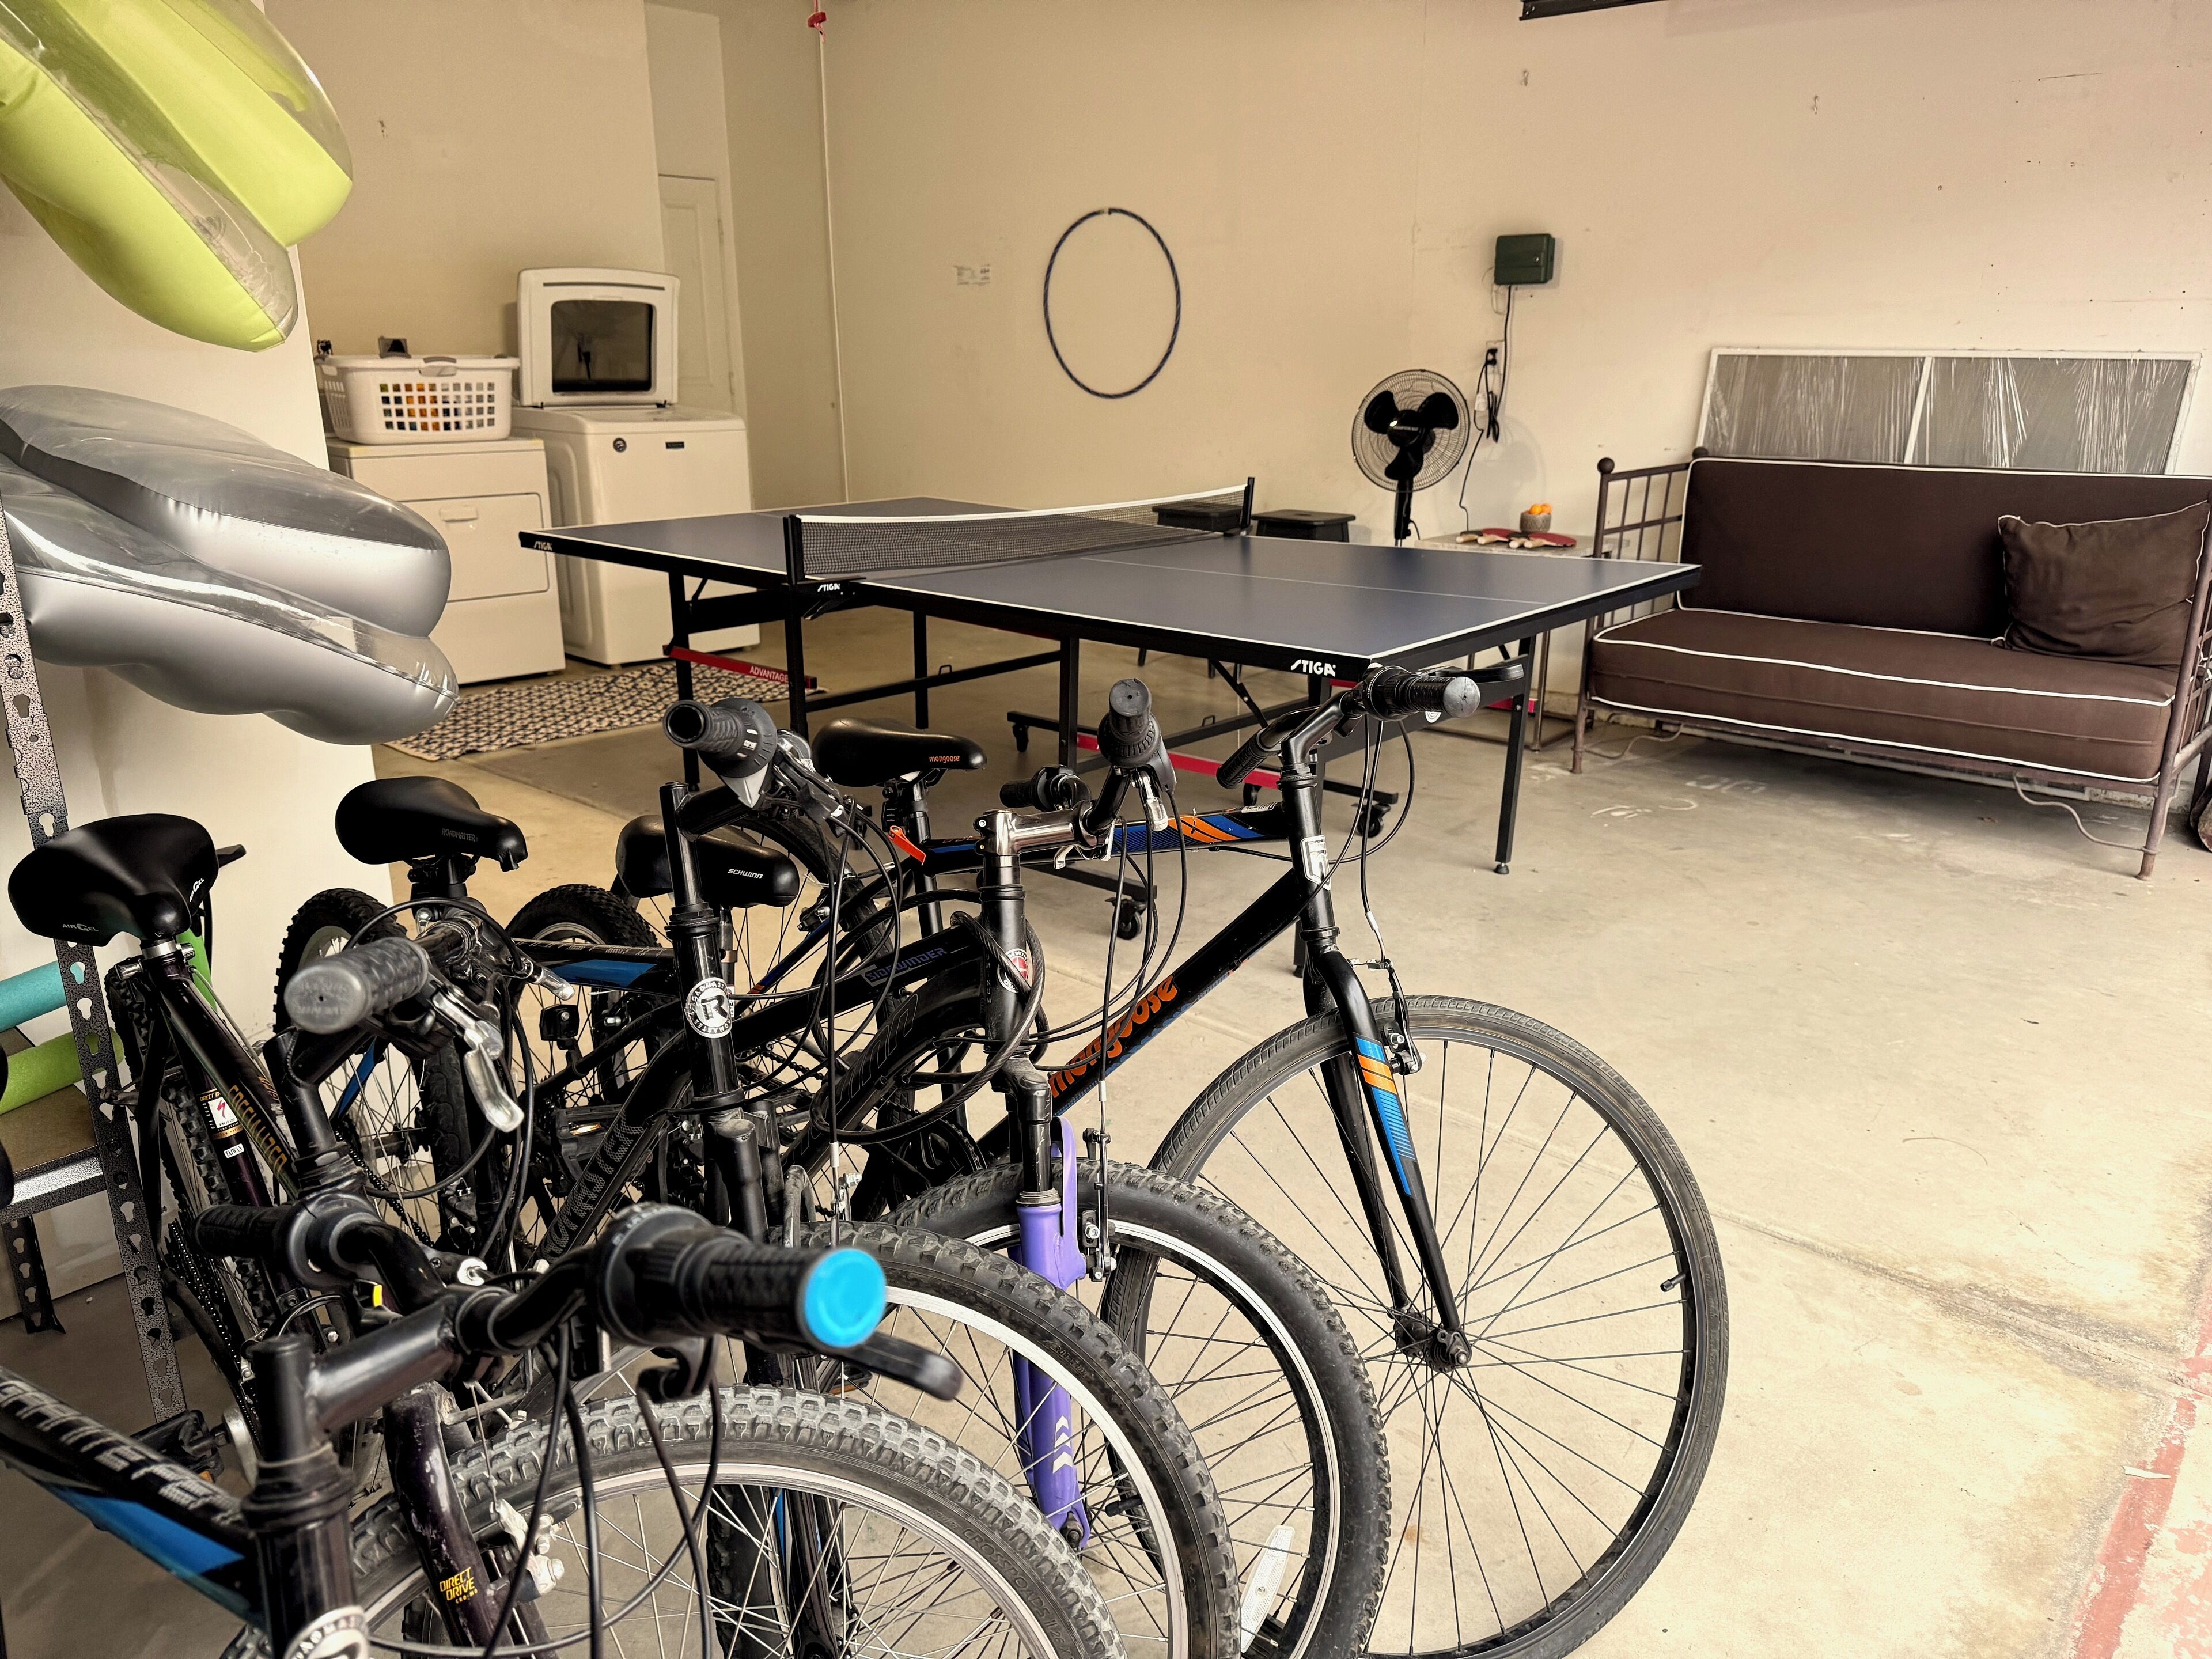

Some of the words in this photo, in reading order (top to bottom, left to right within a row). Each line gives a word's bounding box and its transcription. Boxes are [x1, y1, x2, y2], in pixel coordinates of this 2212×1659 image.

[817, 583, 840, 592] STIGA
[749, 666, 789, 684] ADVANTAGE
[1290, 659, 1336, 677] STIGA
[929, 755, 960, 763] mongoose
[728, 869, 763, 879] SCHWINN
[440, 1566, 471, 1592] DIRECT
[446, 1577, 475, 1601] DRIVE
